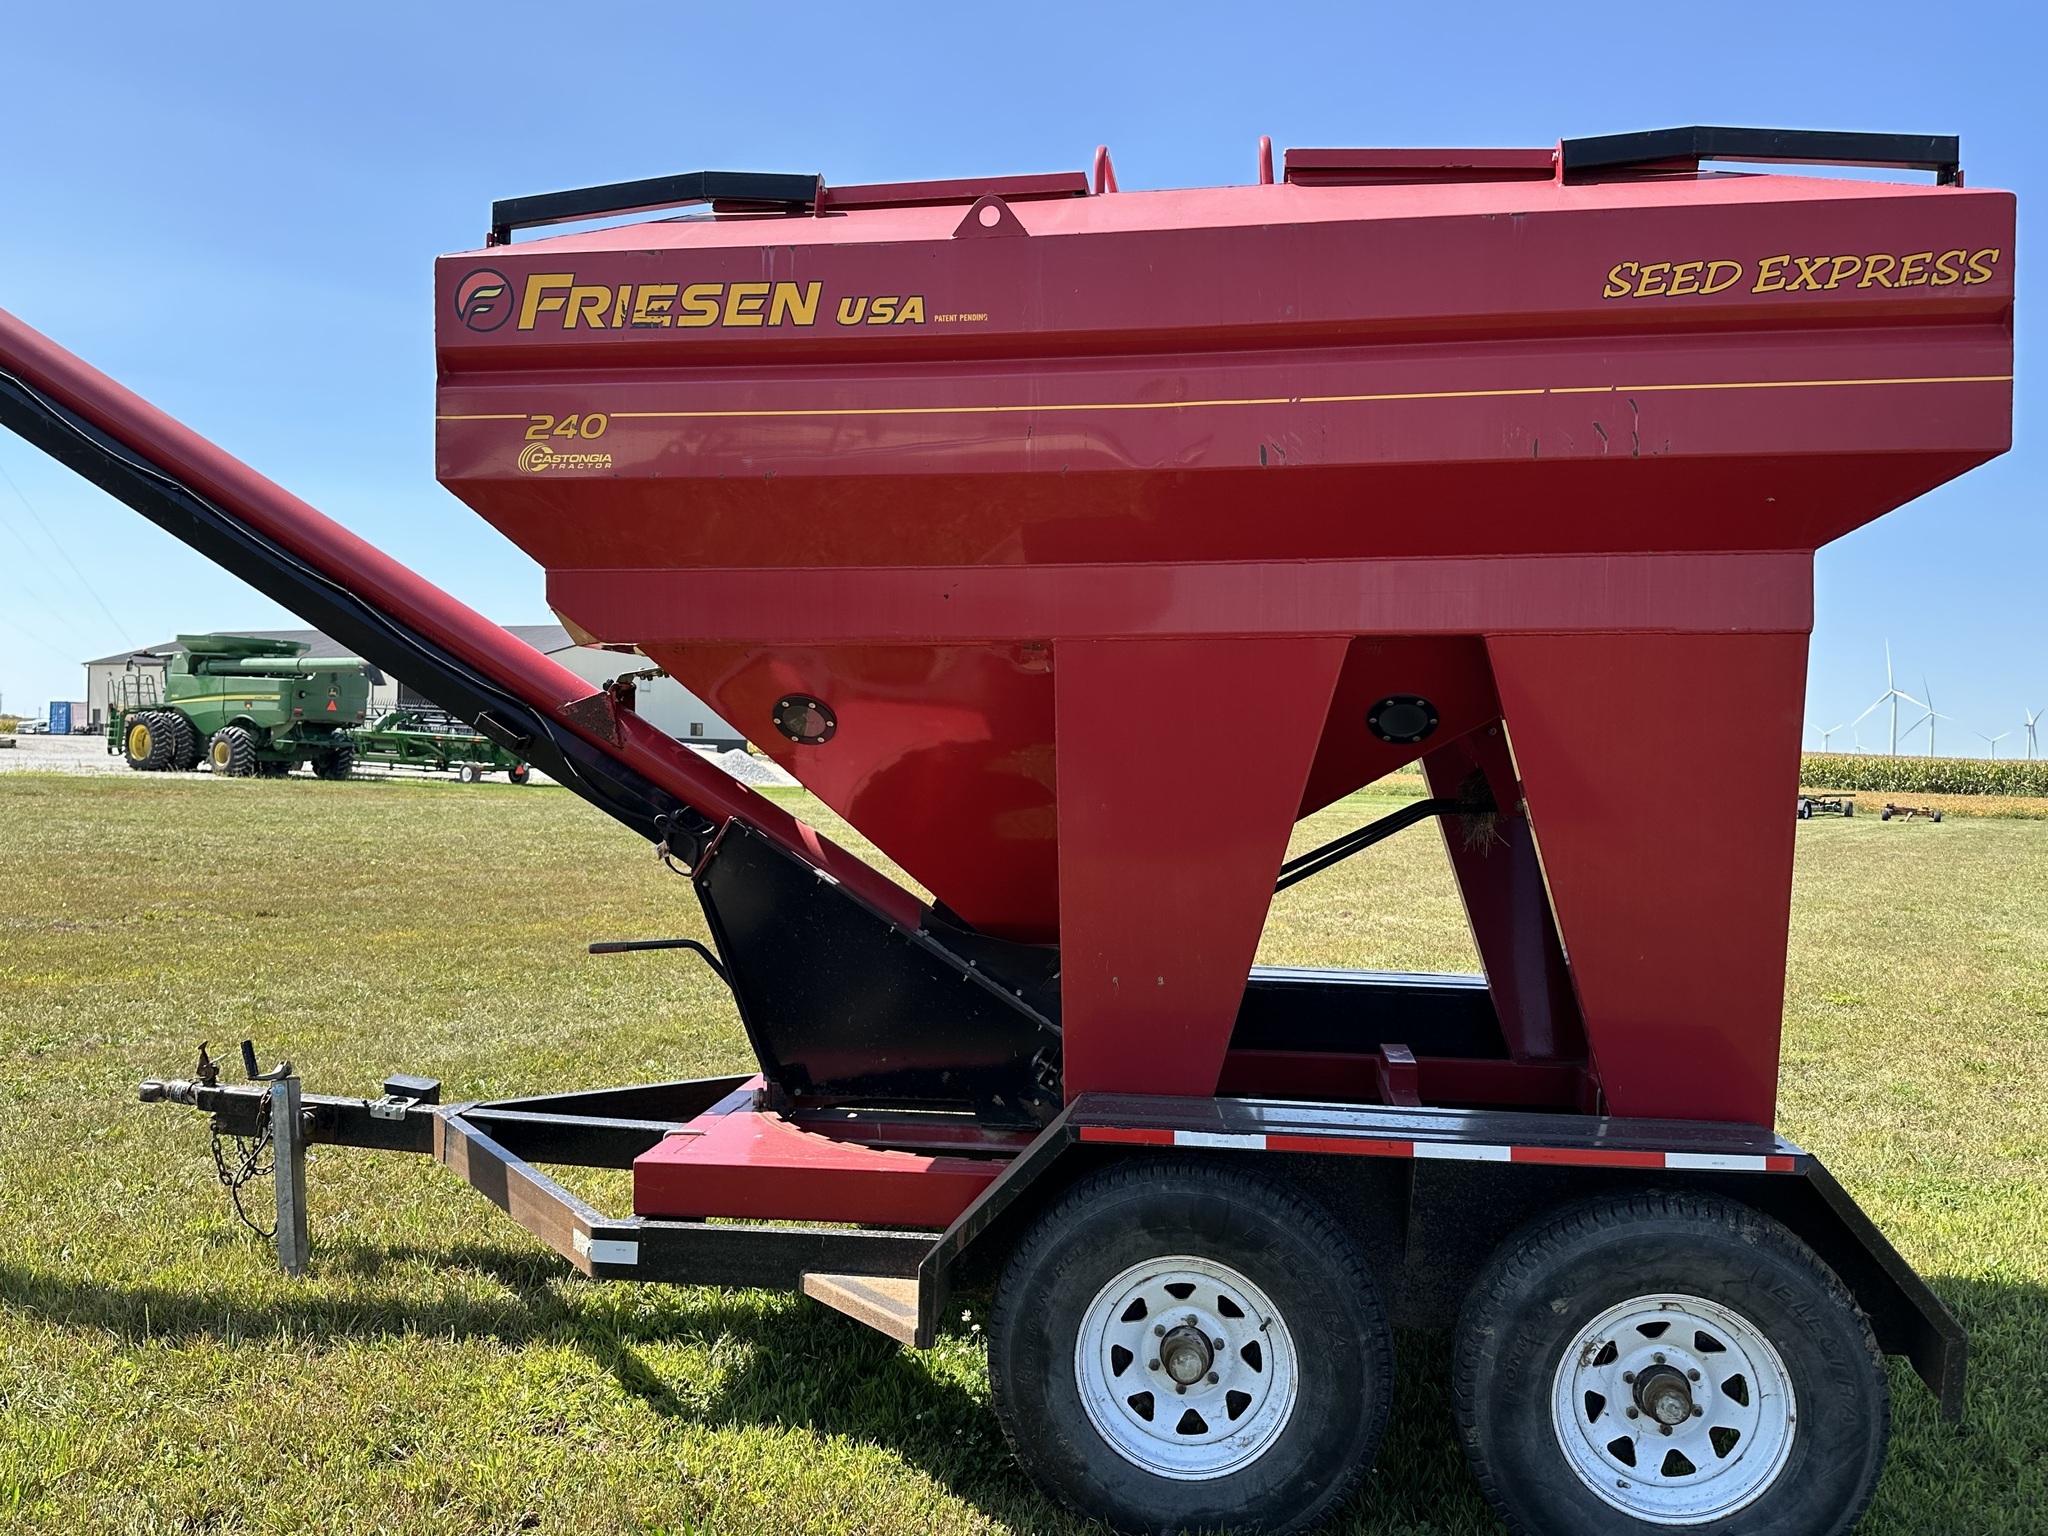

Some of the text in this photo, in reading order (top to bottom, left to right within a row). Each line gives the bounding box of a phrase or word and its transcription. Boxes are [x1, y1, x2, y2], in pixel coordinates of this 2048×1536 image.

[1603, 247, 2000, 299] SEED EXPRESS
[516, 271, 926, 331] FRIESEN USA
[934, 314, 958, 323] PATENT
[525, 413, 608, 440] 240
[531, 453, 612, 463] CASTONGIA
